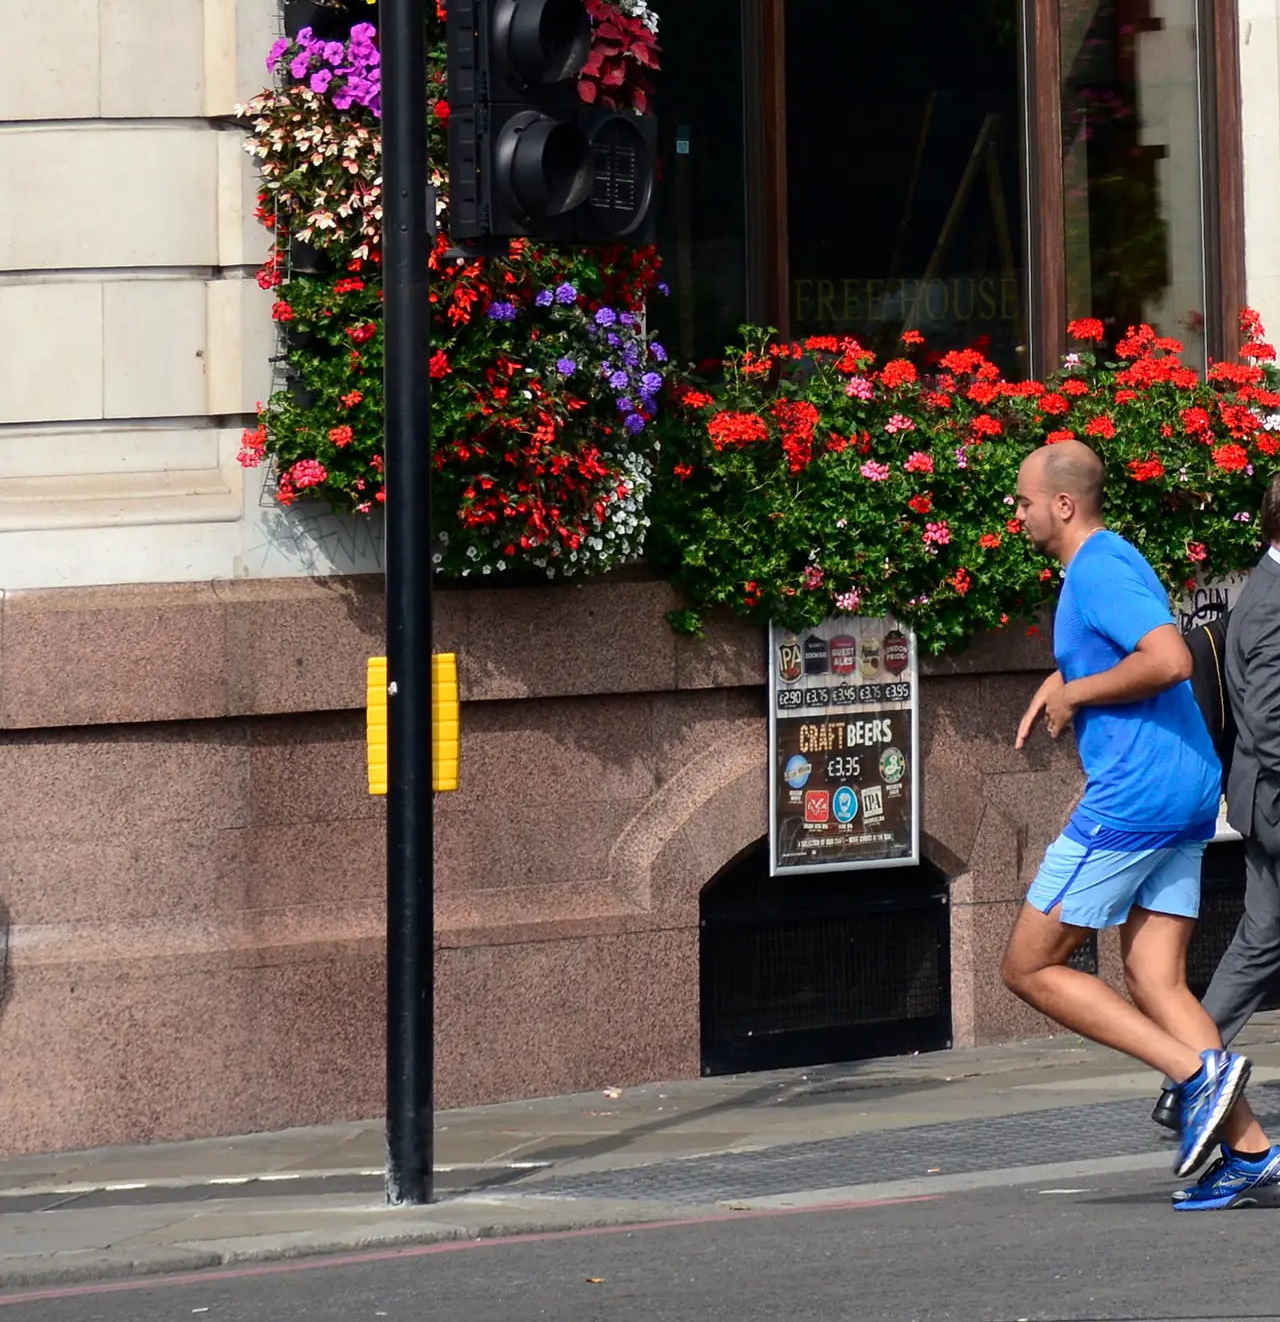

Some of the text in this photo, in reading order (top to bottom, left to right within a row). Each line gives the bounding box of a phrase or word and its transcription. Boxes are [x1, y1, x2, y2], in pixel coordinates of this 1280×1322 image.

[792, 278, 1018, 321] FREE HOUSE
[832, 647, 855, 656] GUEST
[779, 647, 801, 672] IPA
[833, 657, 853, 666] ALES
[779, 690, 801, 704] £2.90
[806, 688, 828, 703] £3.75
[832, 687, 856, 701] £3.45
[859, 685, 882, 699] £3.75
[885, 683, 909, 697] £3.95
[799, 719, 892, 752] CRAFT BEERS
[827, 756, 860, 777] £3.35
[863, 791, 882, 812] IPA
